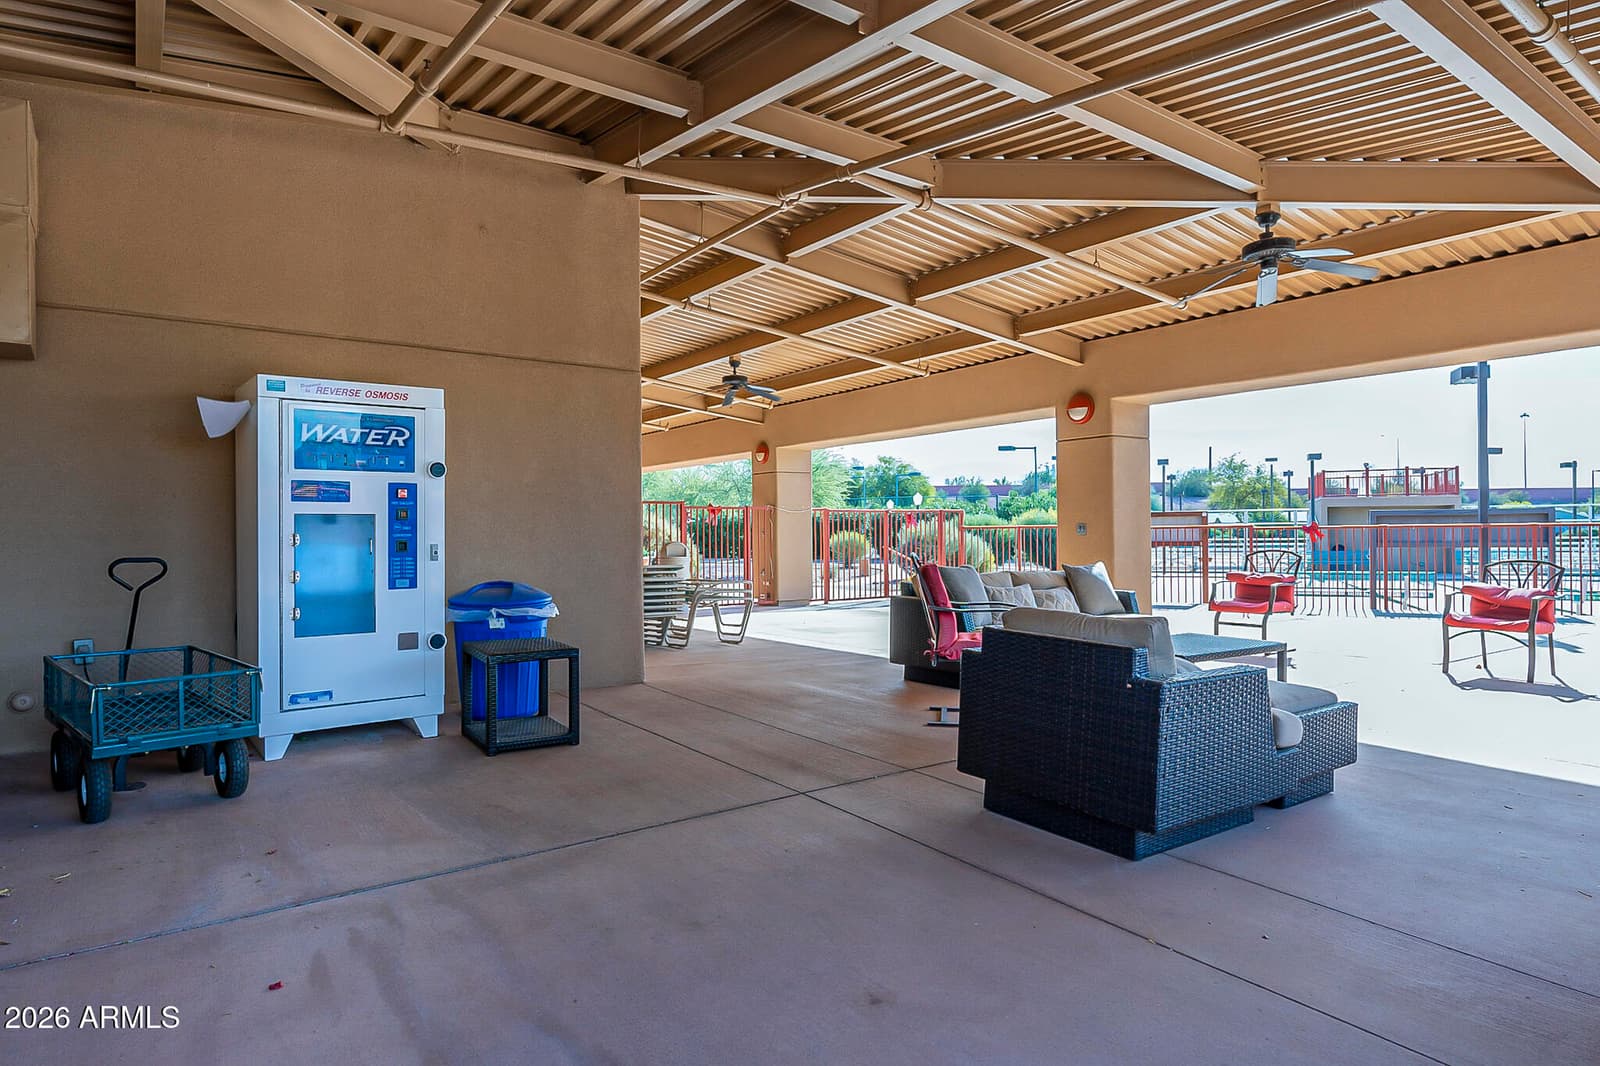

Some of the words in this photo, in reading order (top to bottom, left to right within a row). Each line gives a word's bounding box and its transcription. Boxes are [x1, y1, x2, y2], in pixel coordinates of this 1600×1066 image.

[316, 386, 362, 398] REVERSE
[365, 390, 409, 401] OSMOSIS
[301, 423, 410, 447] WATER
